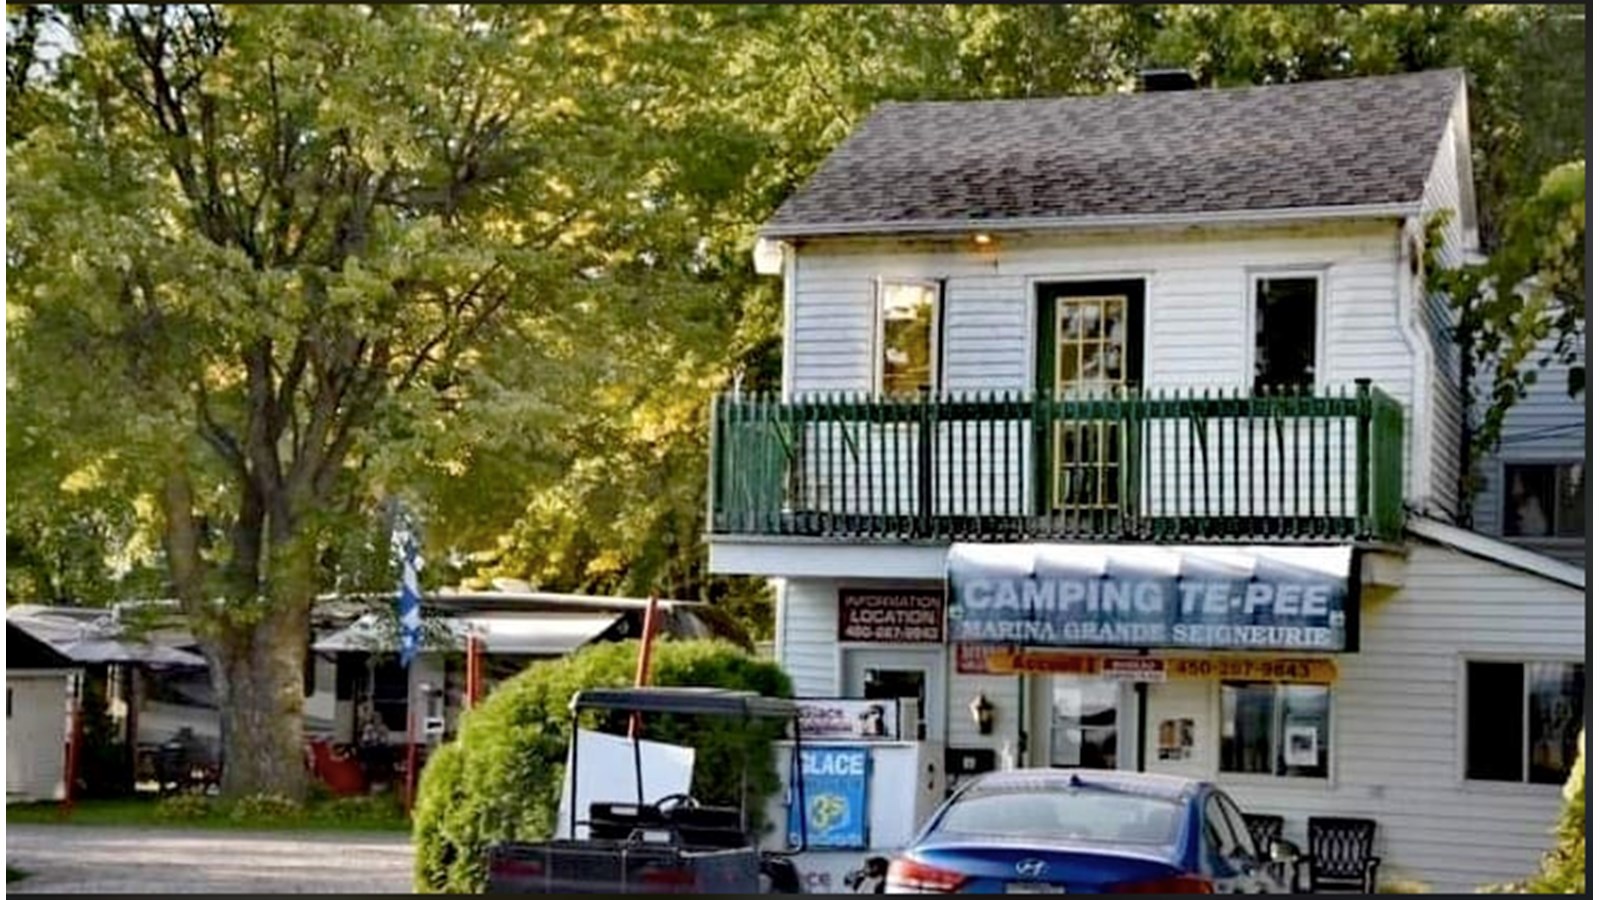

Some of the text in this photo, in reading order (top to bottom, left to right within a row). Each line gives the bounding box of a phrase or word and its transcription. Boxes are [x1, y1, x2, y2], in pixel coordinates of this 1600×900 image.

[963, 579, 1331, 617] CAMPING TE-PEE
[849, 609, 935, 625] LOCATION
[962, 619, 1331, 647] MARINA GRANDE SEIGNEURIE
